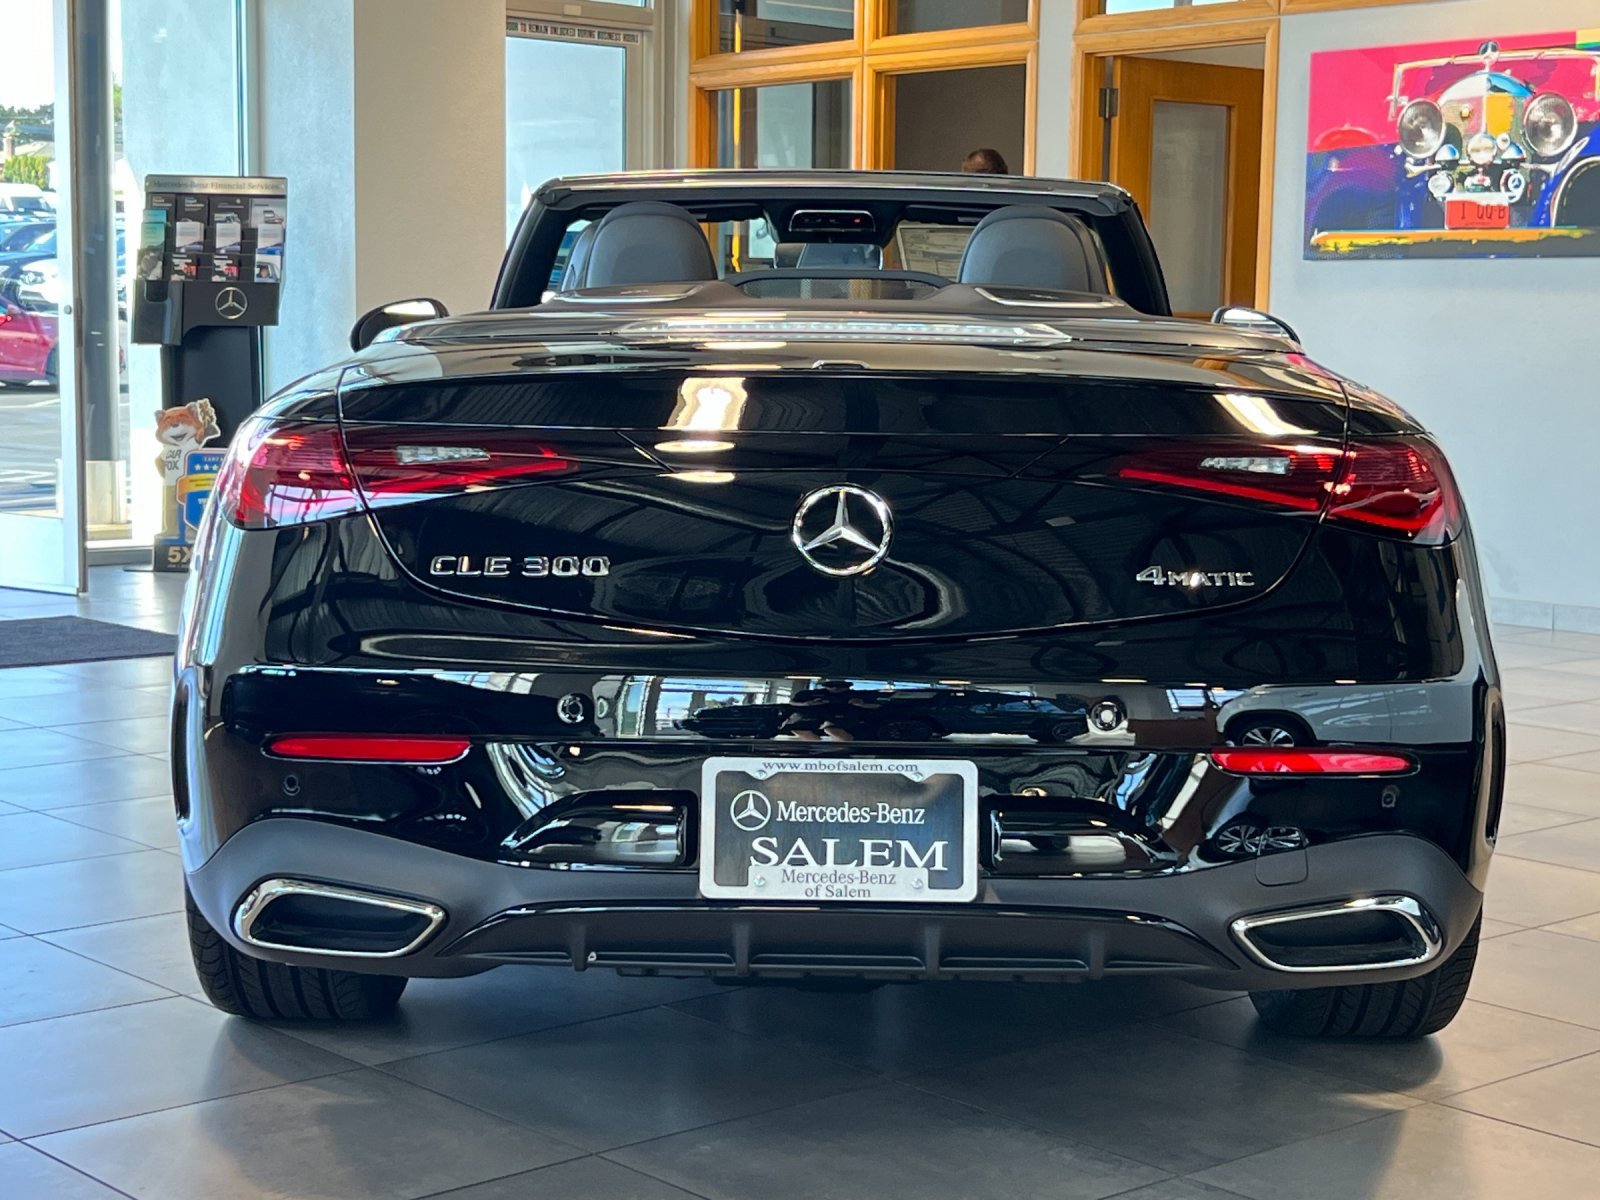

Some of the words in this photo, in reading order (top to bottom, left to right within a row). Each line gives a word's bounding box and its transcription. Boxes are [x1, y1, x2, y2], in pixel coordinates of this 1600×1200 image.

[529, 24, 549, 35] REMAIN
[211, 181, 245, 191] Financial
[247, 182, 280, 192] Services
[430, 556, 512, 576] CLE
[521, 556, 610, 576] 300
[1136, 565, 1255, 587] 4MATIC
[761, 760, 919, 772] www.mbofsalem.com
[775, 800, 926, 825] Mercedes-Benz
[750, 836, 949, 871] SALEM
[781, 868, 897, 885] Mercedes-Benz
[804, 885, 823, 898] of
[825, 885, 872, 898] Salem
